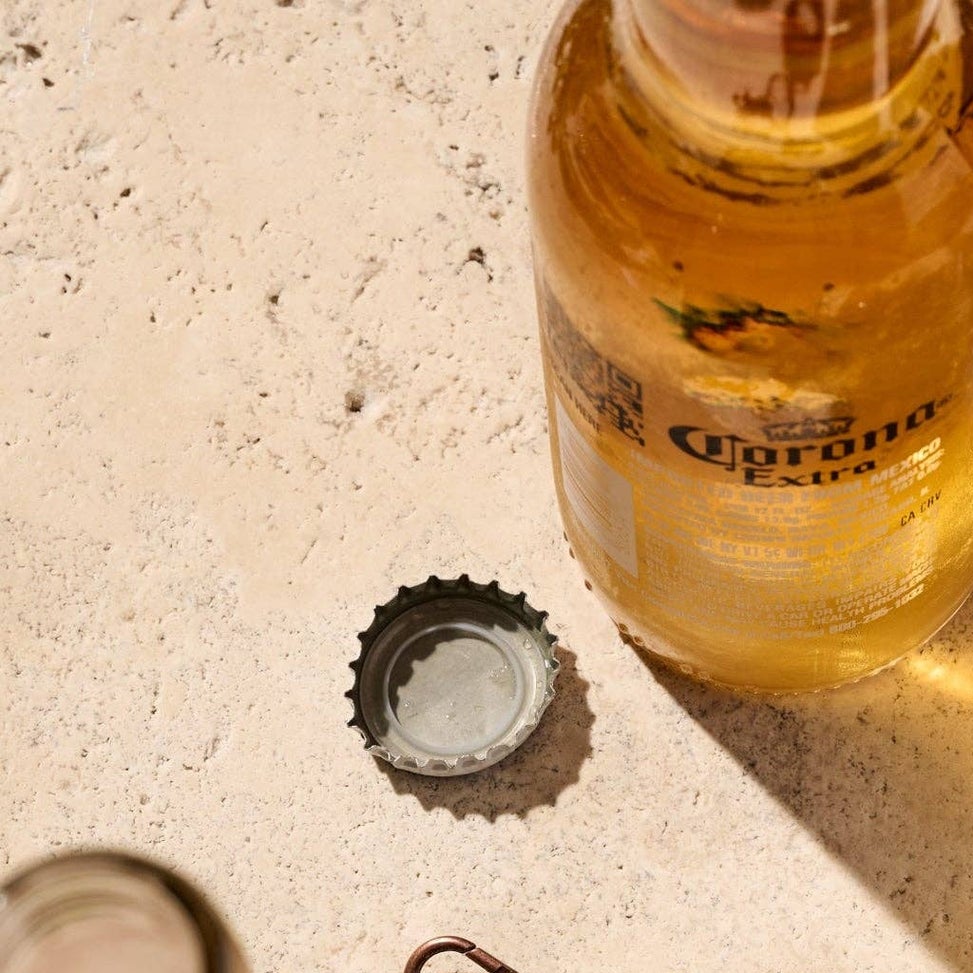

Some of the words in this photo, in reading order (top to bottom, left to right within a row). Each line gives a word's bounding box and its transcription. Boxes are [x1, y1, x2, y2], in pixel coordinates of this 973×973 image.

[741, 459, 876, 489] Extra
[869, 436, 942, 487] MEXICO
[900, 510, 916, 527] CA
[919, 488, 942, 514] CRV
[811, 606, 866, 626] HEALTH
[812, 607, 833, 619] OR
